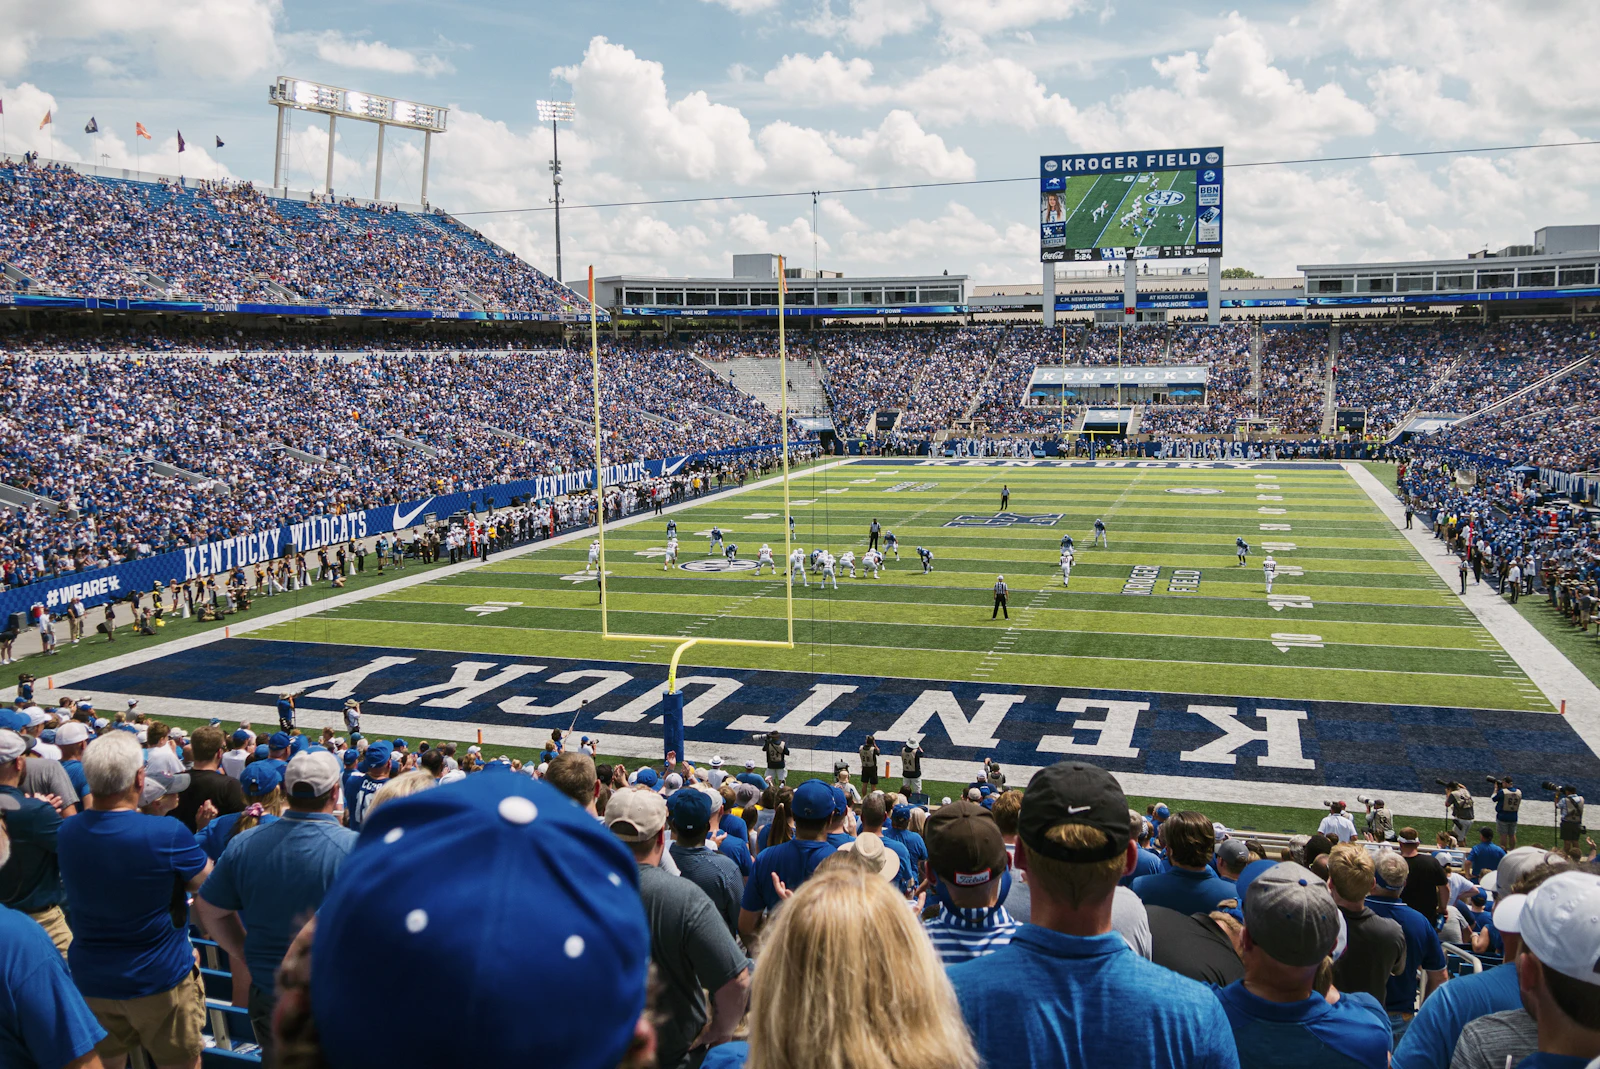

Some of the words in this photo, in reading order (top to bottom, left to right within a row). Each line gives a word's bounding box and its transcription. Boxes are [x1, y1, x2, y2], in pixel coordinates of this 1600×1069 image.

[1062, 156, 1138, 171] KROGER
[1147, 152, 1201, 167] FIELD
[1200, 186, 1219, 194] BBN
[215, 303, 238, 312] DOWN
[1042, 371, 1198, 381] KENTUCKY
[535, 470, 593, 500] KENTUCKY
[184, 527, 281, 581] KENTUCKY
[289, 510, 367, 552] WILDCATS
[1167, 569, 1202, 593] FIELD
[255, 655, 1316, 770] KENTUCKY
